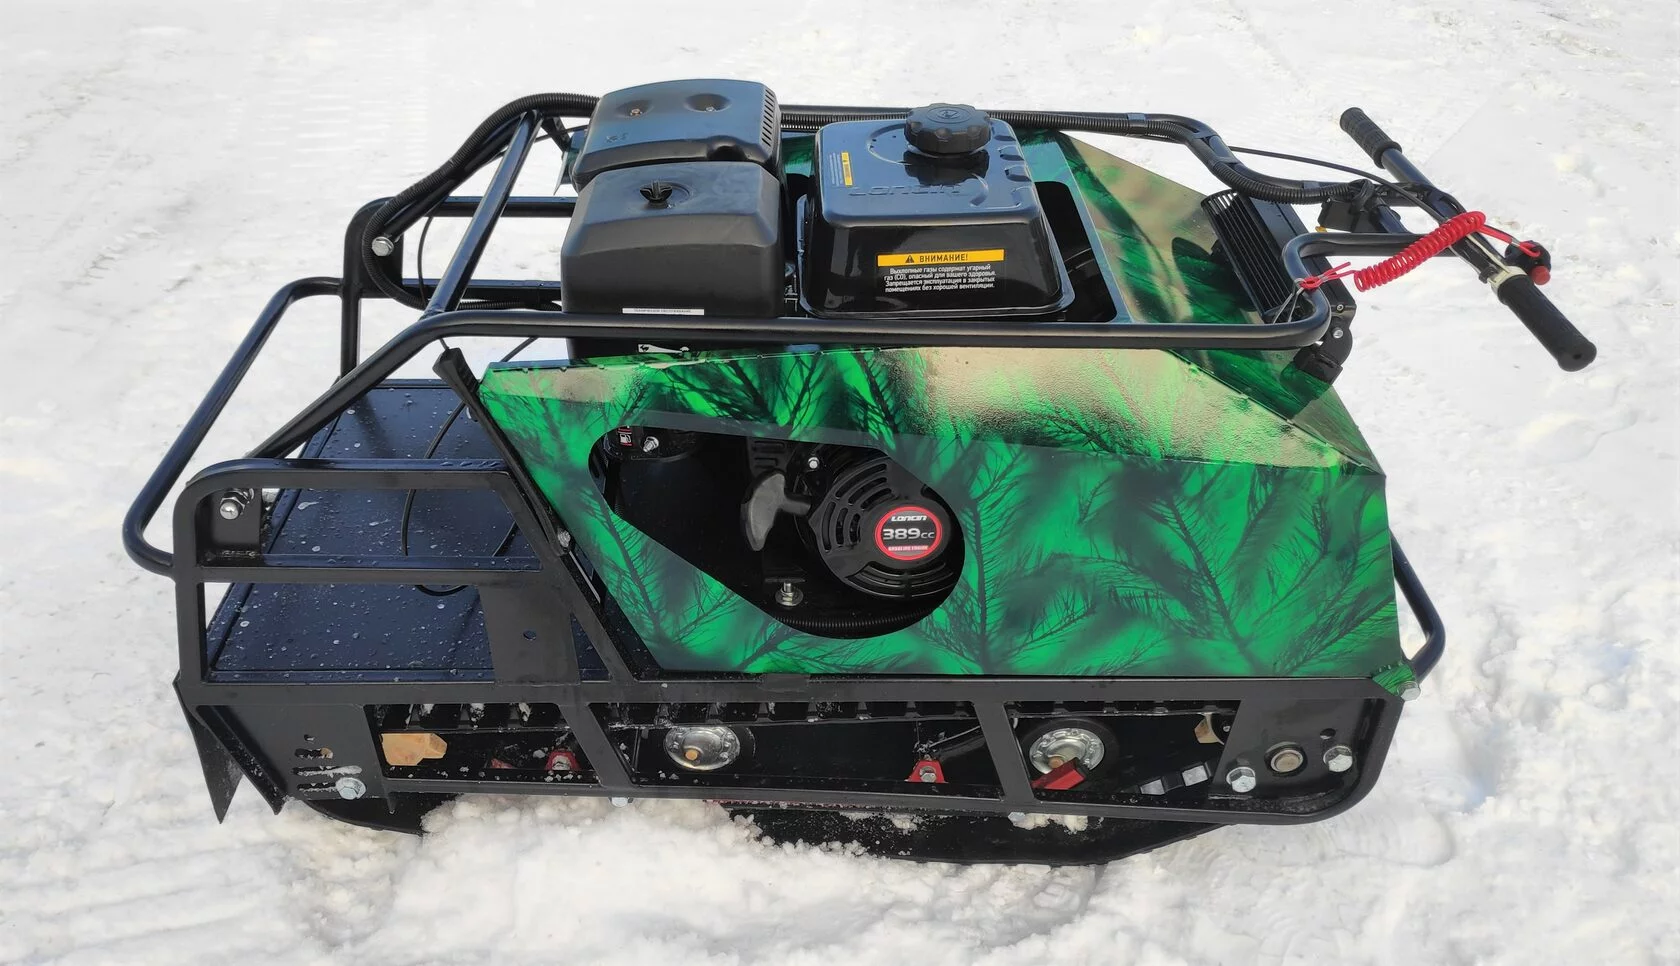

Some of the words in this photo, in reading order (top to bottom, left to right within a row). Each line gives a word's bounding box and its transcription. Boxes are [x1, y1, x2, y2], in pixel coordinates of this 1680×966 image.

[919, 253, 968, 263] ВНИМАНИЕ!
[909, 272, 933, 280] опасный
[885, 279, 922, 287] Запрещается
